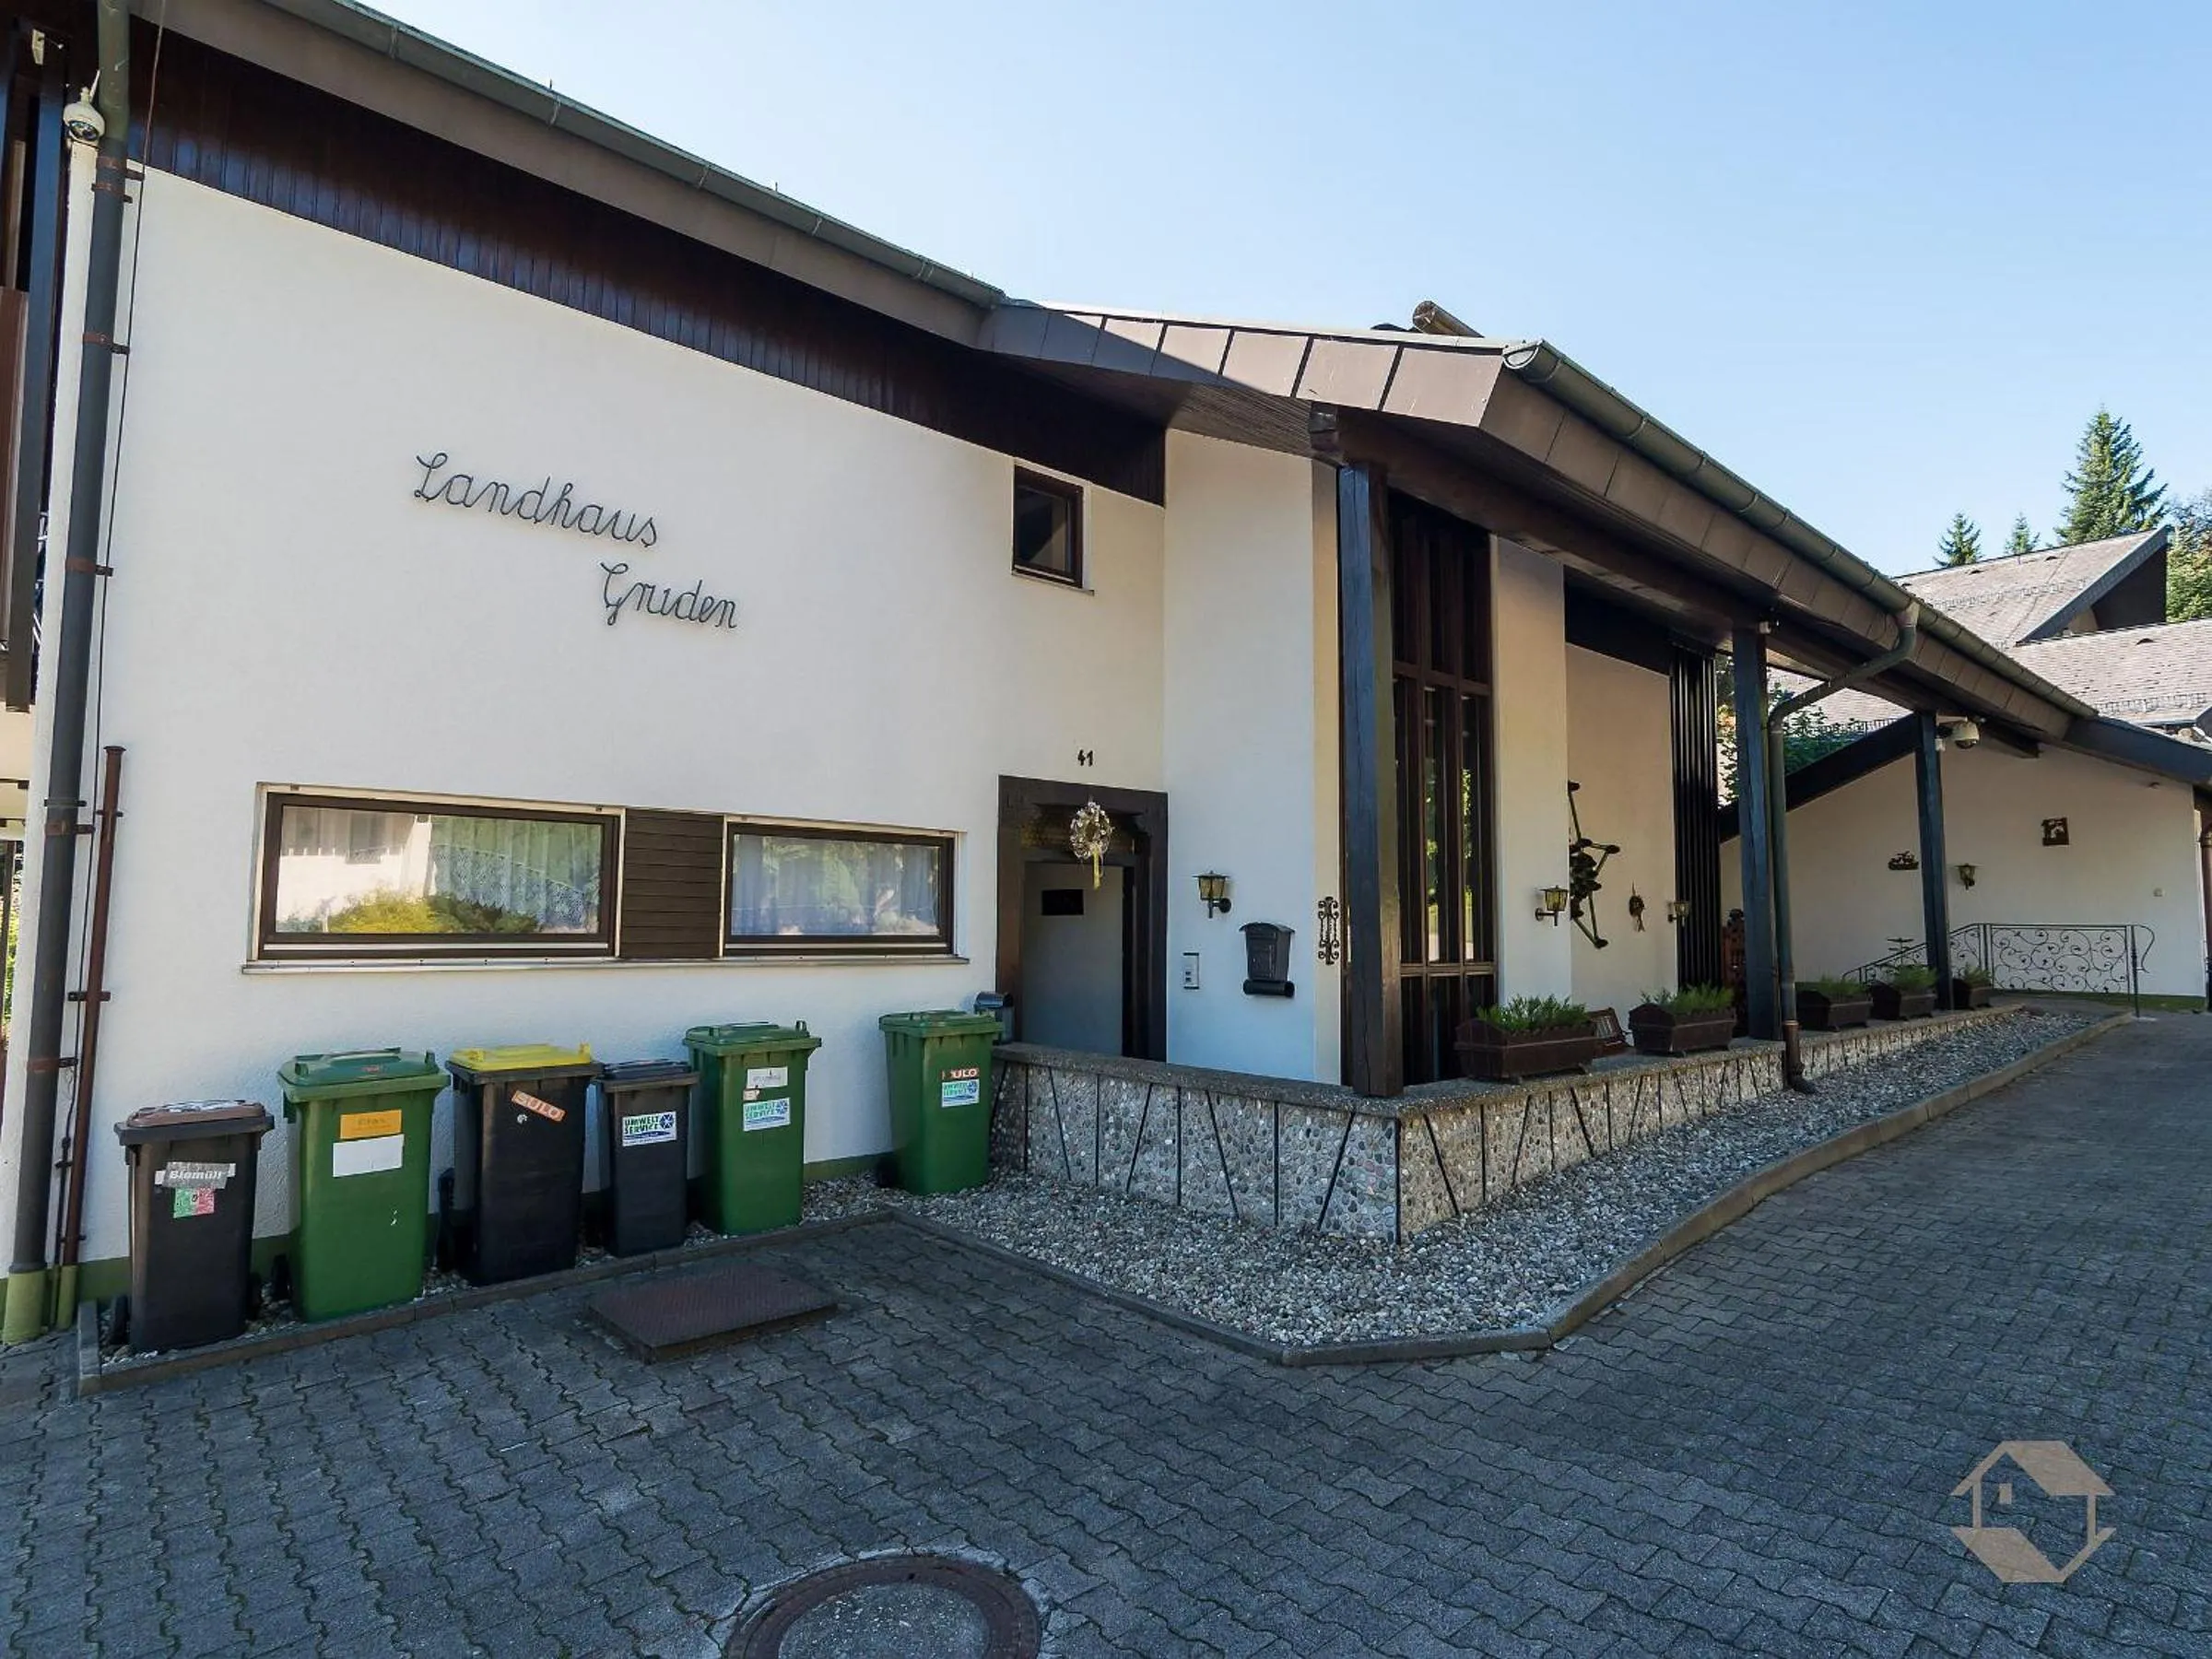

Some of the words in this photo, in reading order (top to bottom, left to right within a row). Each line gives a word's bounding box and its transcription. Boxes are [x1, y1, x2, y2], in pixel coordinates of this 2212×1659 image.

[414, 452, 657, 547] Landhaus
[600, 561, 738, 629] Gruden
[1077, 749, 1093, 767] 41
[625, 1116, 659, 1126] UMWELT
[625, 1124, 659, 1135] SERVICE
